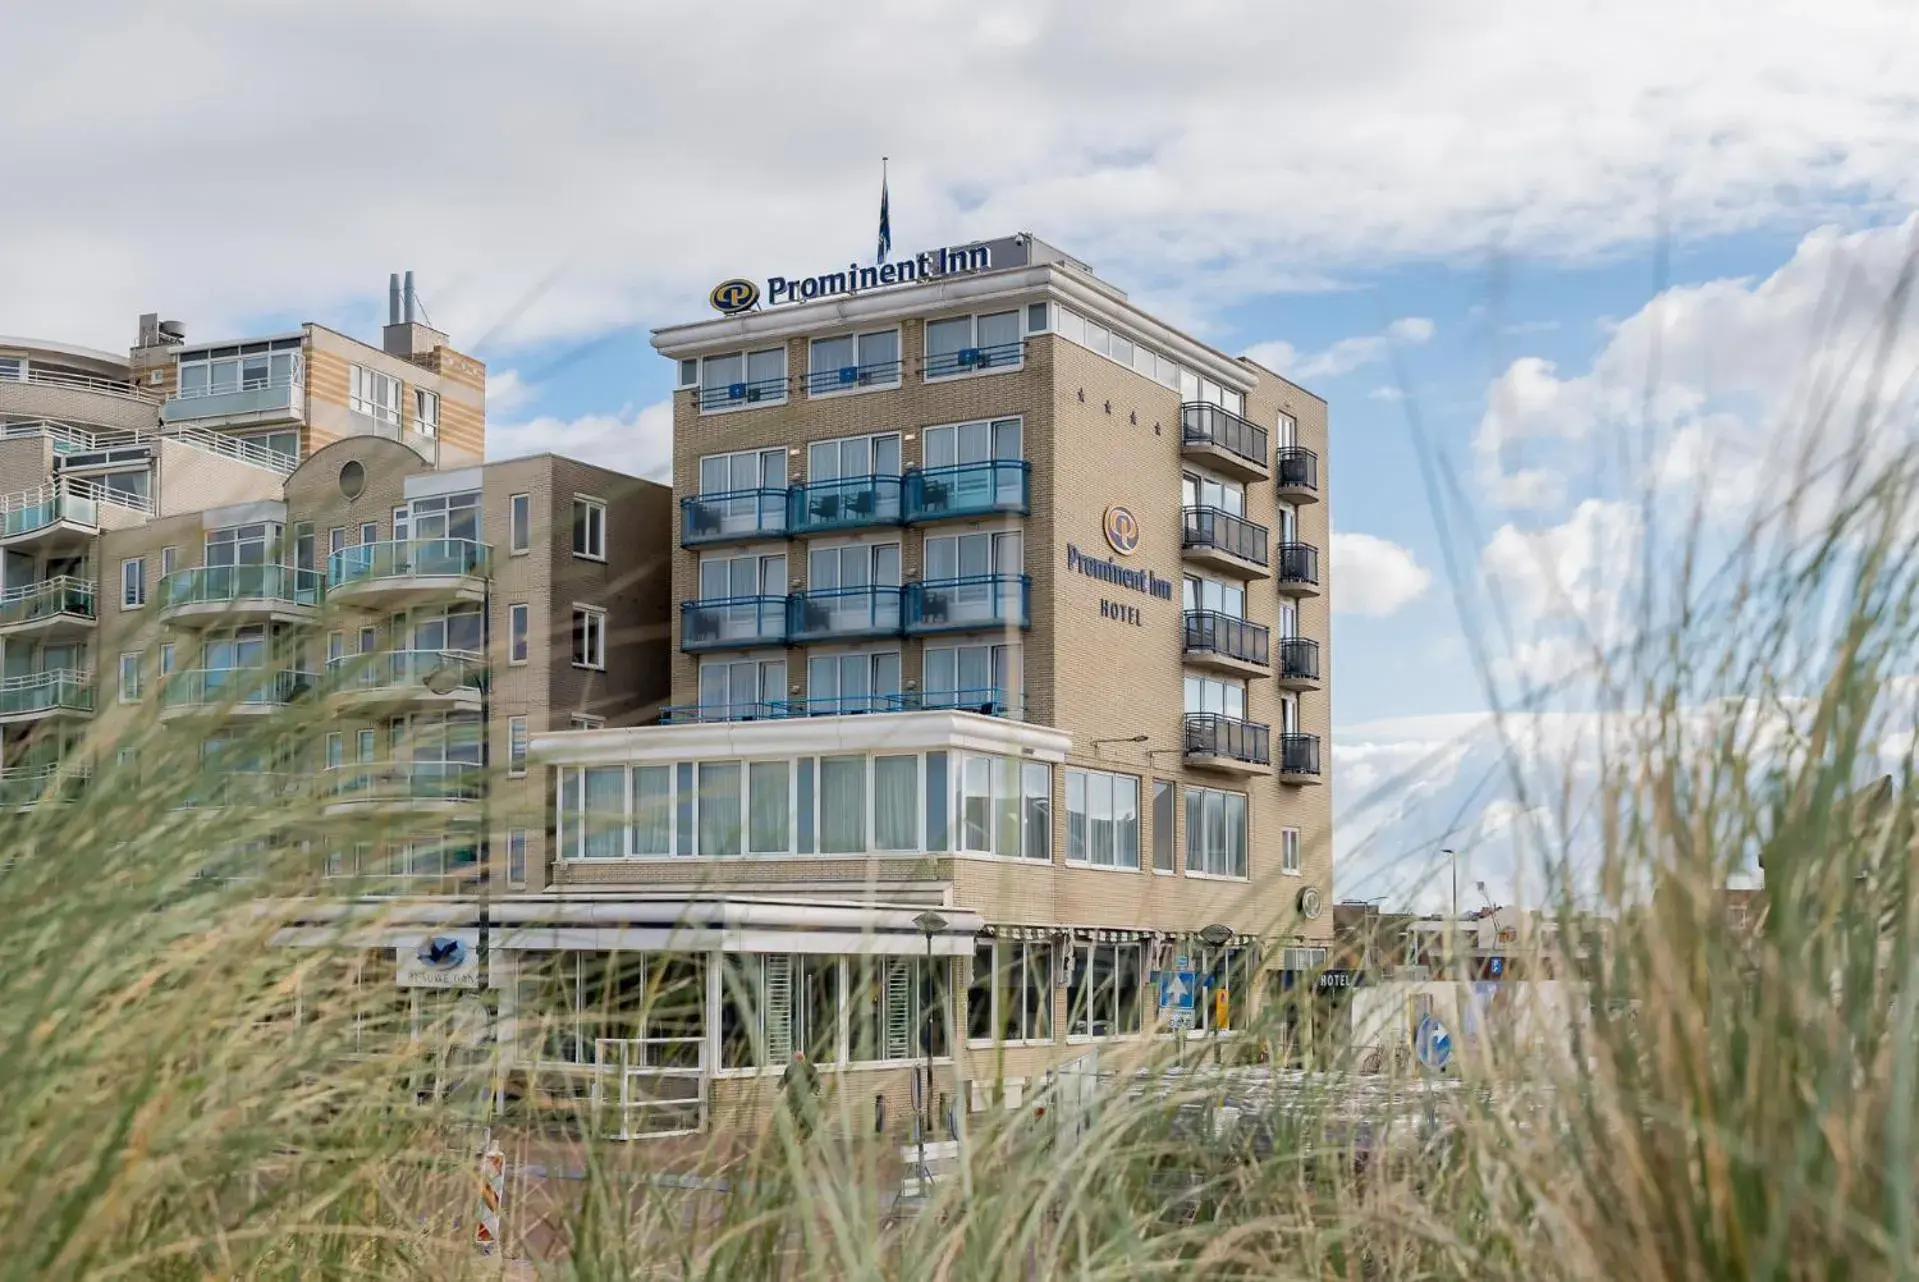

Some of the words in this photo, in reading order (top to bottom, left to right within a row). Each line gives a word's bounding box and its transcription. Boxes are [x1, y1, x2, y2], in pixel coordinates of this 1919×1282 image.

[767, 252, 931, 305] Prominent
[940, 246, 991, 275] Inn
[1066, 543, 1147, 593] Prominent
[1149, 570, 1172, 601] Inn
[1100, 598, 1142, 627] HOTEL
[1320, 974, 1351, 986] HOTEL
